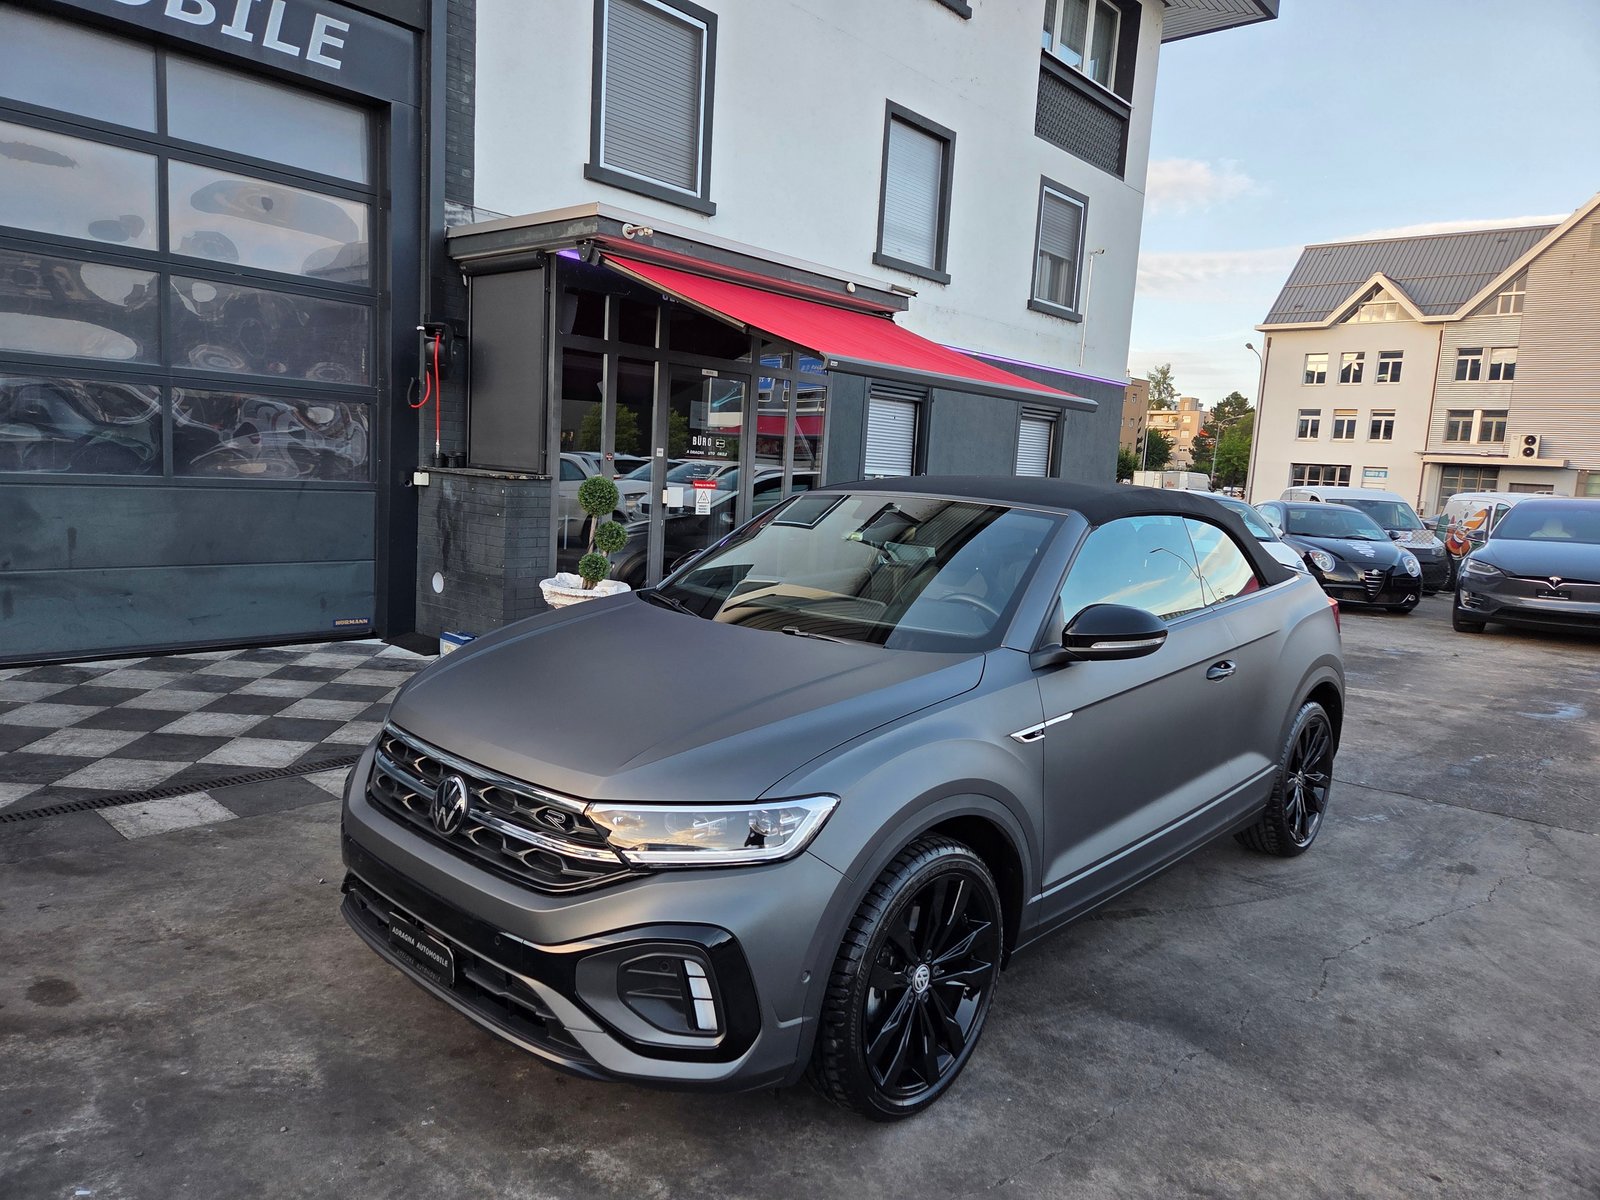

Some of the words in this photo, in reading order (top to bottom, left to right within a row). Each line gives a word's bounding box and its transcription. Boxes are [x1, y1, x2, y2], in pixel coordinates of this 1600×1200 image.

[114, 0, 350, 70] BILE
[692, 435, 712, 447] BÜRO
[391, 926, 415, 946] ADRAGNA
[416, 941, 449, 968] AUTOMOBILE
